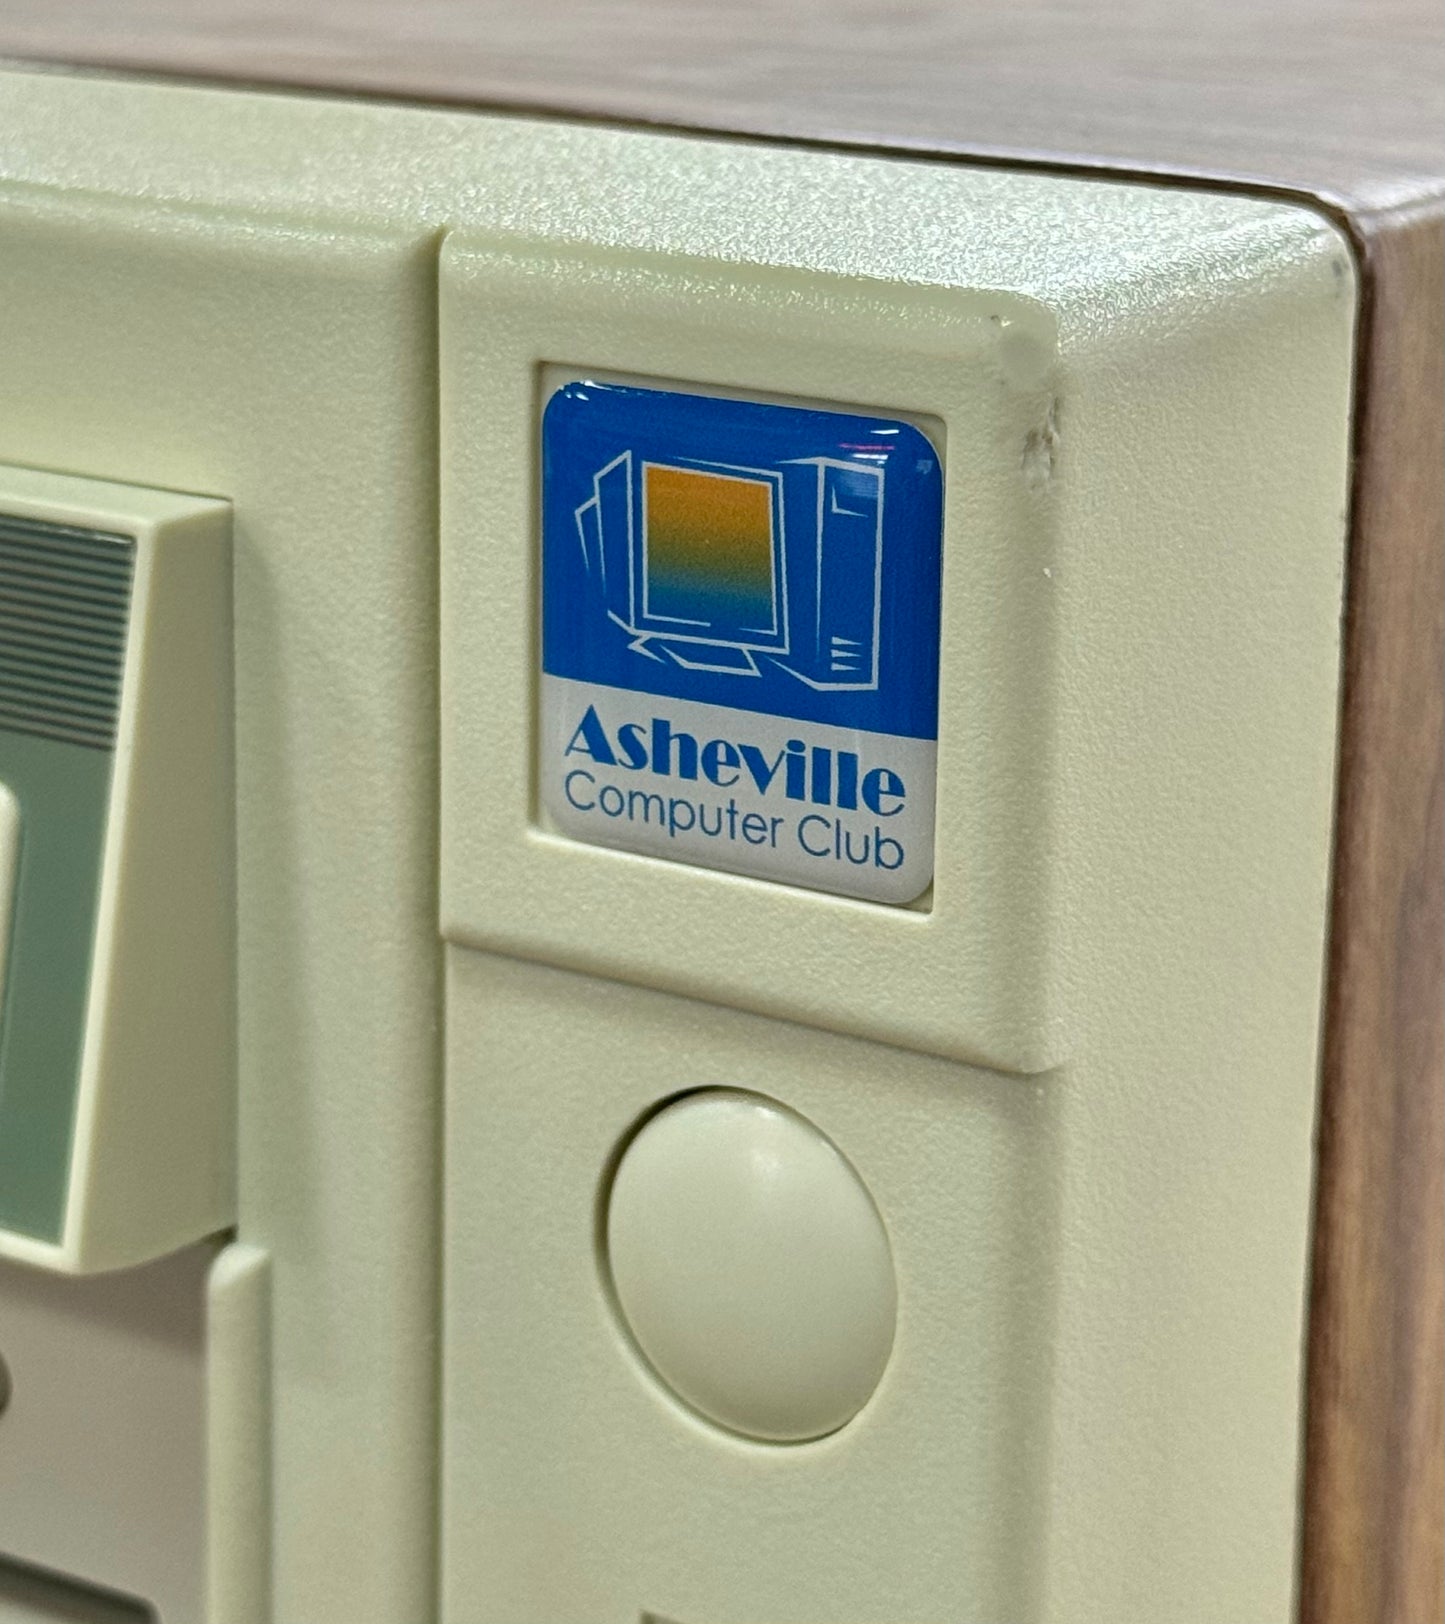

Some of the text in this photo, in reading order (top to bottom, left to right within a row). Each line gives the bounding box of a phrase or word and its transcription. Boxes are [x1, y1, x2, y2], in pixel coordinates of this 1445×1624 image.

[565, 704, 906, 816] Asheville
[565, 769, 905, 870] Computer Club
